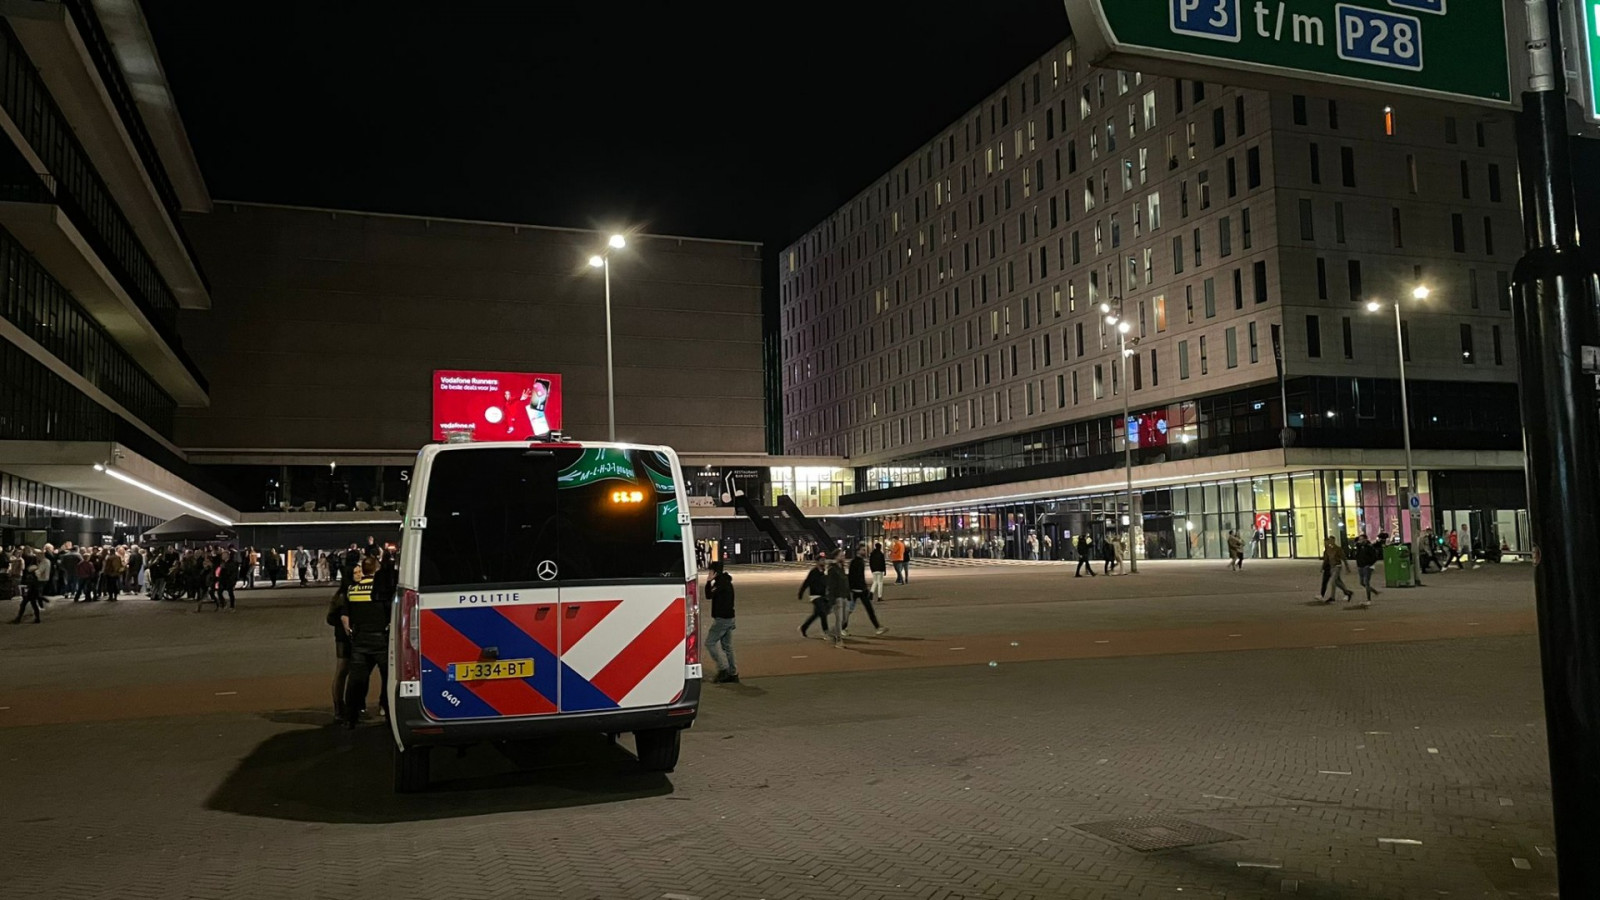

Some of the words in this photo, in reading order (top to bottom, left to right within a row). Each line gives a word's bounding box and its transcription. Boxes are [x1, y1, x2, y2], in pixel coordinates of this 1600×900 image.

[1253, 1, 1325, 47] t/m
[1344, 15, 1414, 59] P28
[459, 592, 520, 604] POLITIE
[462, 662, 526, 678] J-334-BT
[441, 690, 461, 707] 0401
